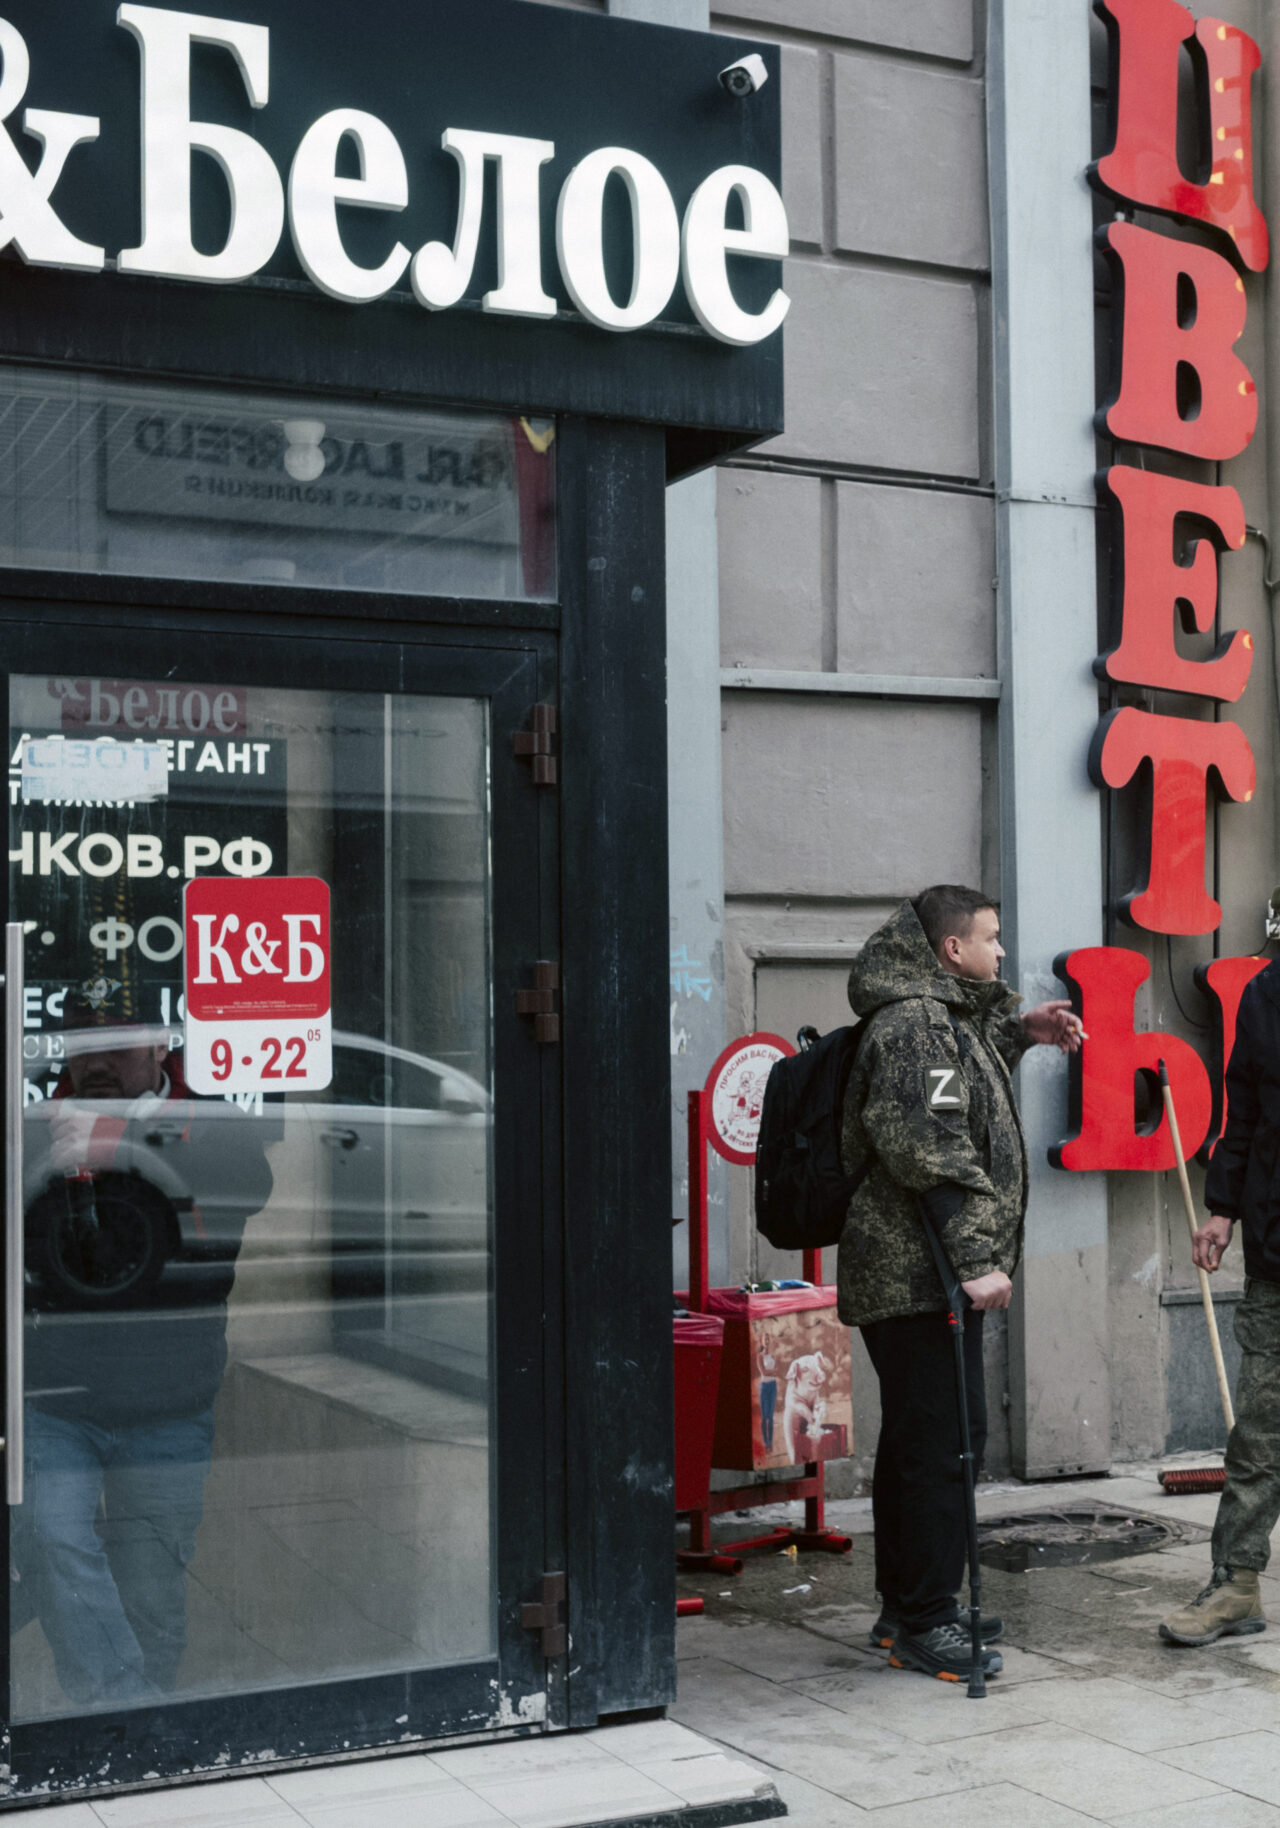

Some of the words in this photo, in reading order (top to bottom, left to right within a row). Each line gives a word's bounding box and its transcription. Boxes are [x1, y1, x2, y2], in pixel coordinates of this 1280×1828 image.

[192, 913, 325, 985] К&Б
[719, 1053, 748, 1090] ПРОСИМ
[750, 1050, 767, 1059] ВАС
[930, 1068, 961, 1105] Z
